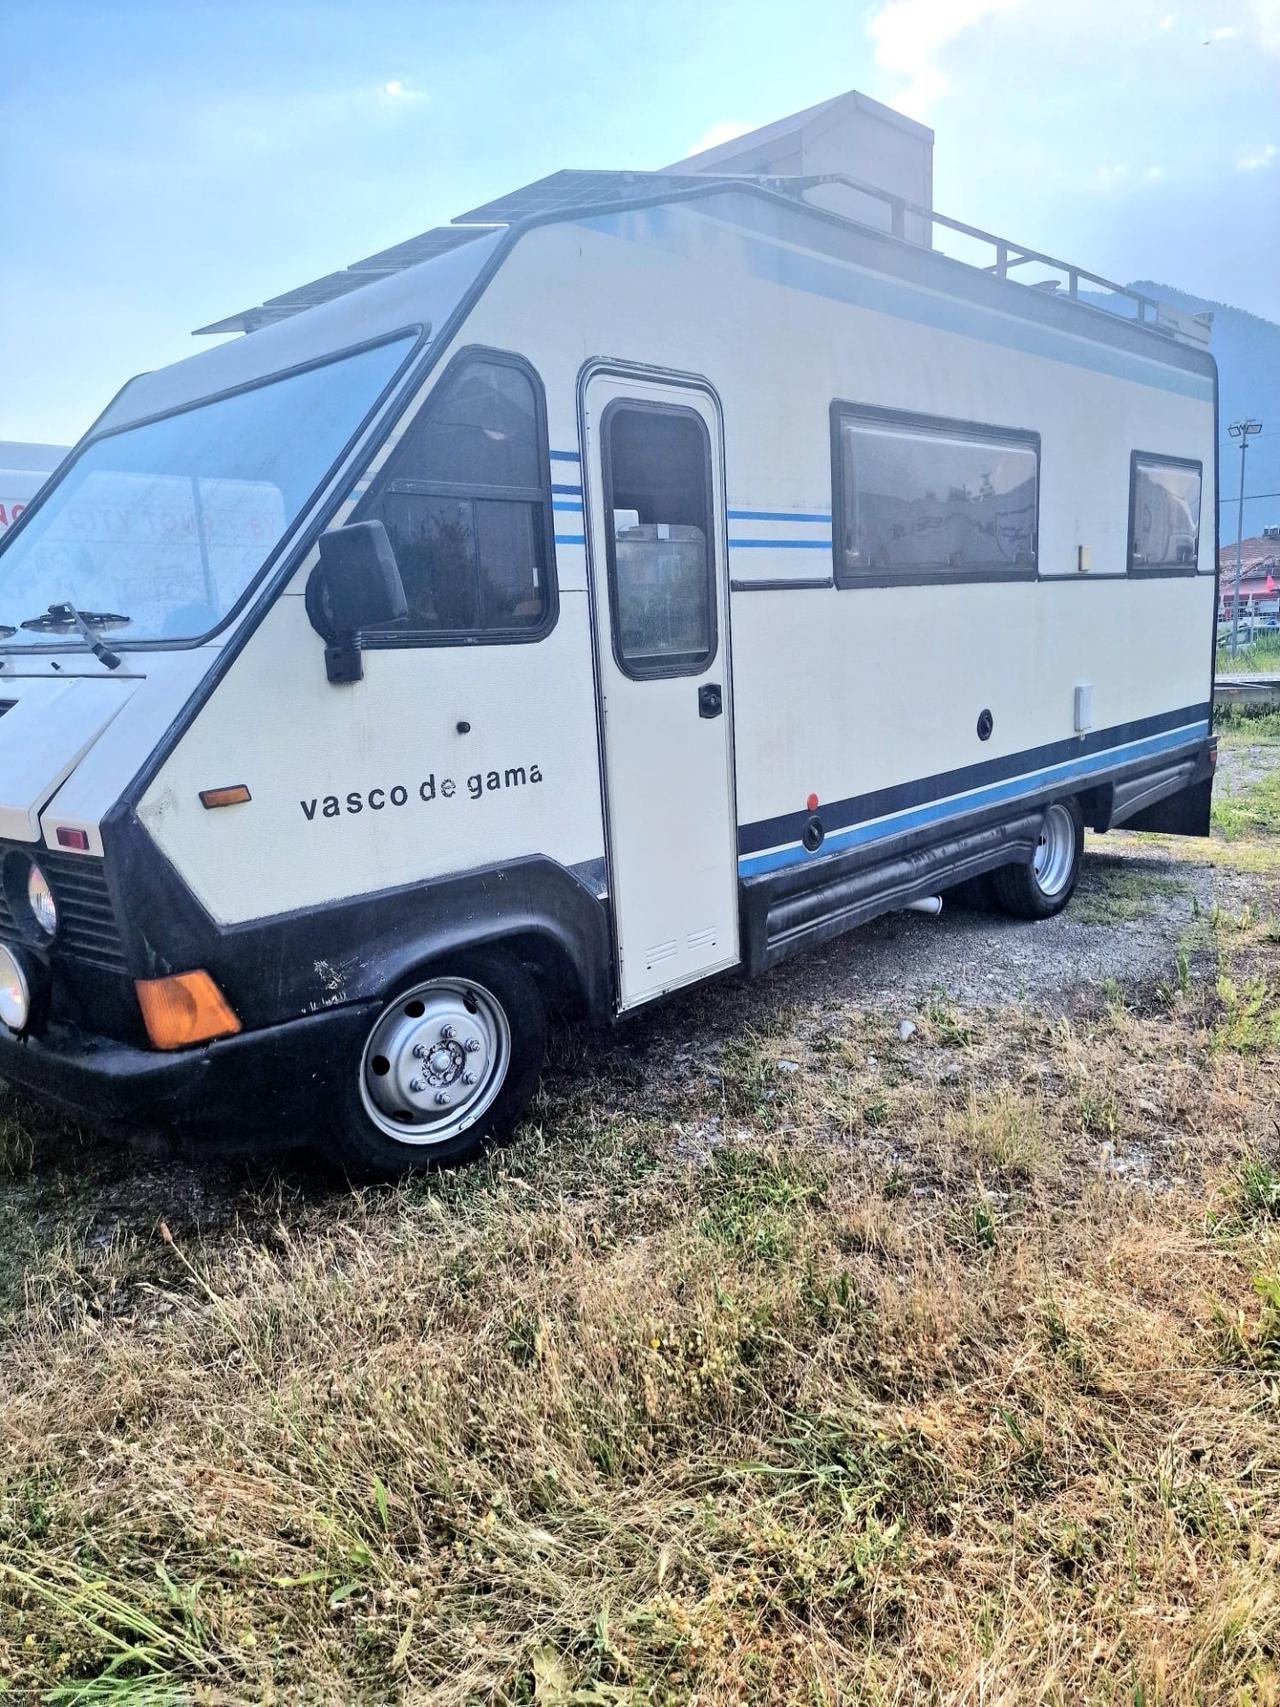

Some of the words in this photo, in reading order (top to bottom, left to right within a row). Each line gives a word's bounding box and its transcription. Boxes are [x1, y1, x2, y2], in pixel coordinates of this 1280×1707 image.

[300, 785, 408, 821] vasco
[419, 773, 457, 801] de
[467, 764, 543, 800] gama
